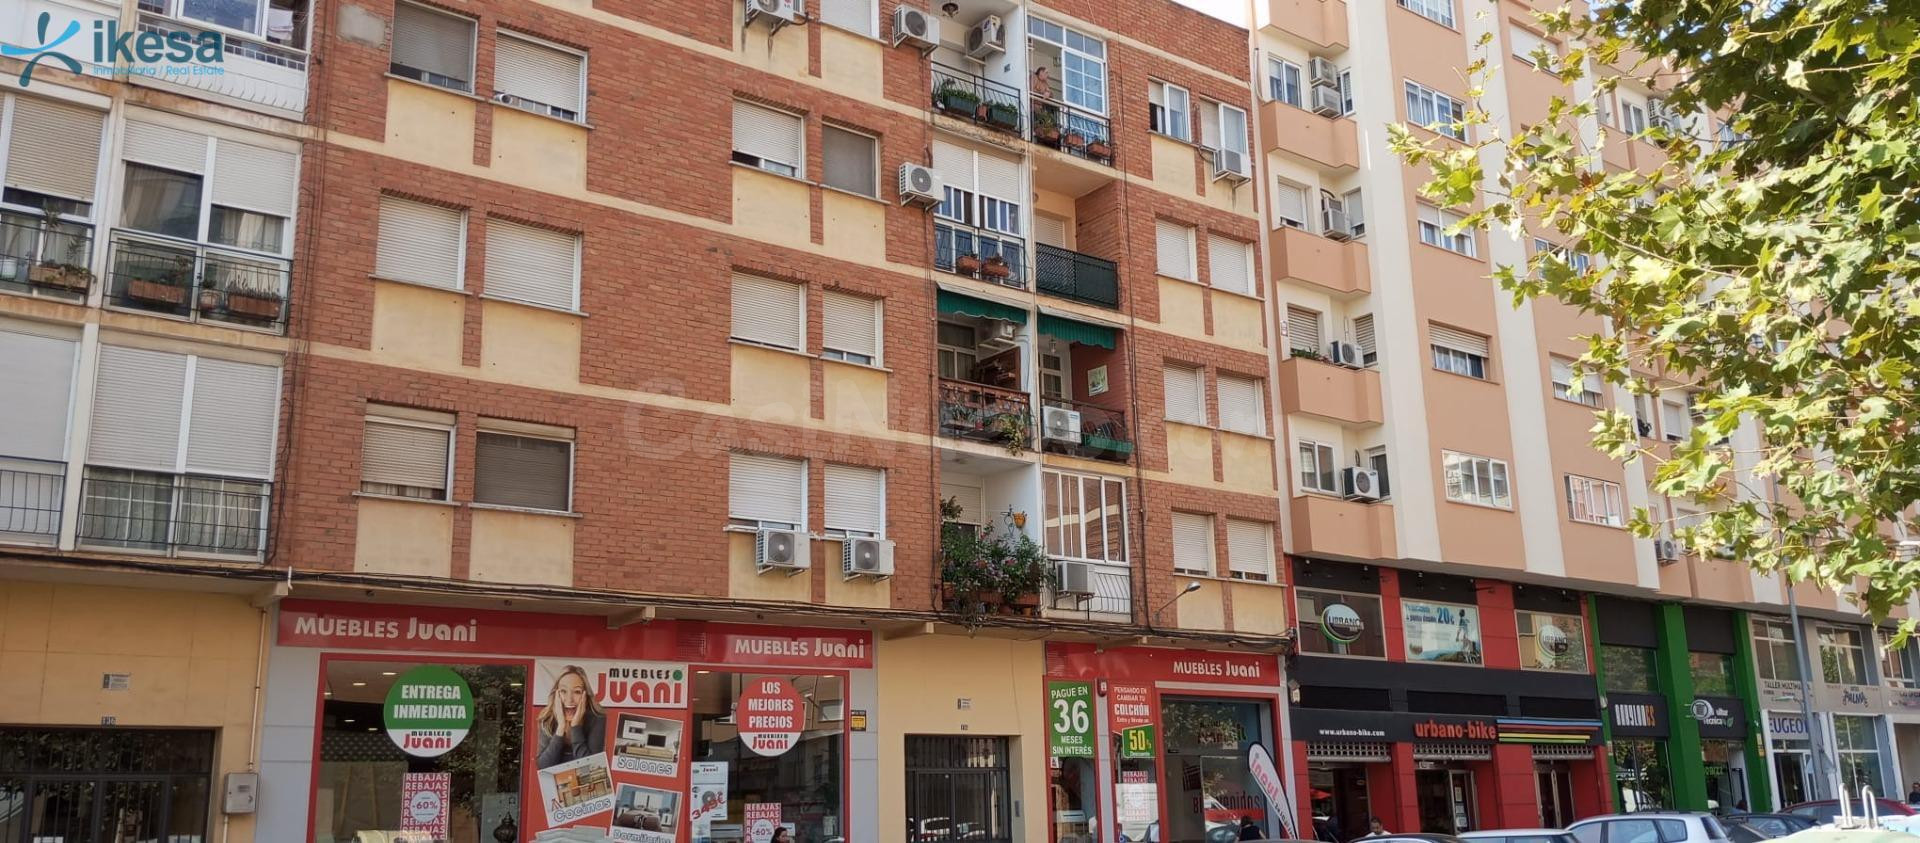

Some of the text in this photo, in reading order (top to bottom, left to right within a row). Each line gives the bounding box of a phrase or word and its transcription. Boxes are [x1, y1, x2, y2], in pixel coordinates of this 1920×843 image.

[294, 616, 478, 642] MUEBLES Juani
[734, 638, 865, 659] MUEBLES Juani
[608, 667, 671, 680] MUEBLES
[1173, 660, 1261, 678] MUEBLES Juani
[401, 684, 461, 700] ENTREGA
[594, 672, 682, 705] Juani
[761, 681, 781, 695] LOS
[1051, 686, 1089, 699] PAGUE EN
[393, 704, 467, 720] INMEDIATA
[748, 698, 794, 712] MEJORES
[1114, 703, 1150, 716] COLCHÓN
[748, 714, 793, 729] PRECIOS
[1053, 698, 1090, 734] 36
[1414, 720, 1497, 740] urbano-bike
[403, 733, 452, 750] Juani
[751, 735, 789, 750] Juani
[1060, 735, 1083, 744] MESES
[1052, 744, 1093, 755] SIN INTERÉS
[616, 755, 674, 776] Salones
[405, 772, 449, 782] REBAJAS
[405, 782, 449, 791] REBAJAS
[411, 801, 438, 810] -60%
[552, 796, 613, 822] Cocinas
